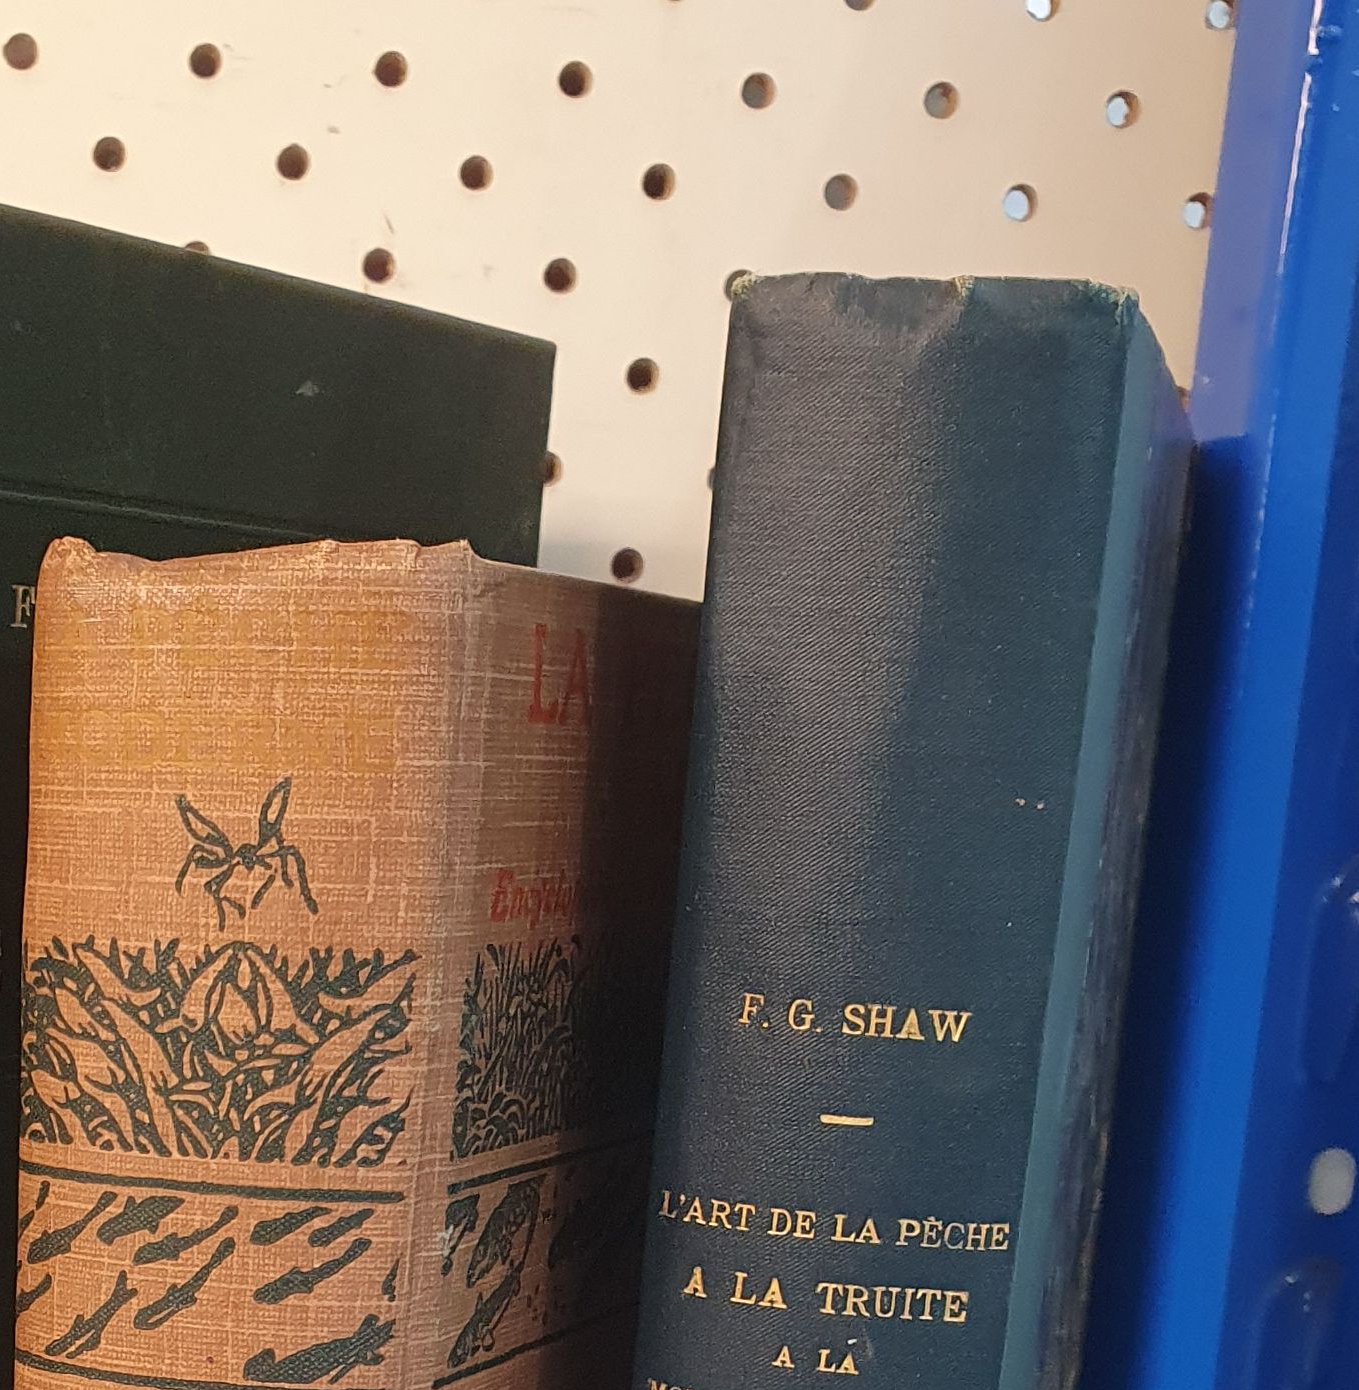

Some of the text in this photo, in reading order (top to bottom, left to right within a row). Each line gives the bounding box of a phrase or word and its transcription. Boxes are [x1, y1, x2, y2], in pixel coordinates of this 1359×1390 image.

[738, 991, 974, 1044] F. G. SHAW
[658, 1189, 757, 1232] L'ART
[767, 1207, 817, 1241] DE
[830, 1213, 882, 1246] LA
[682, 1265, 971, 1324] A LA TRUITE
[771, 1345, 860, 1376] A LA
